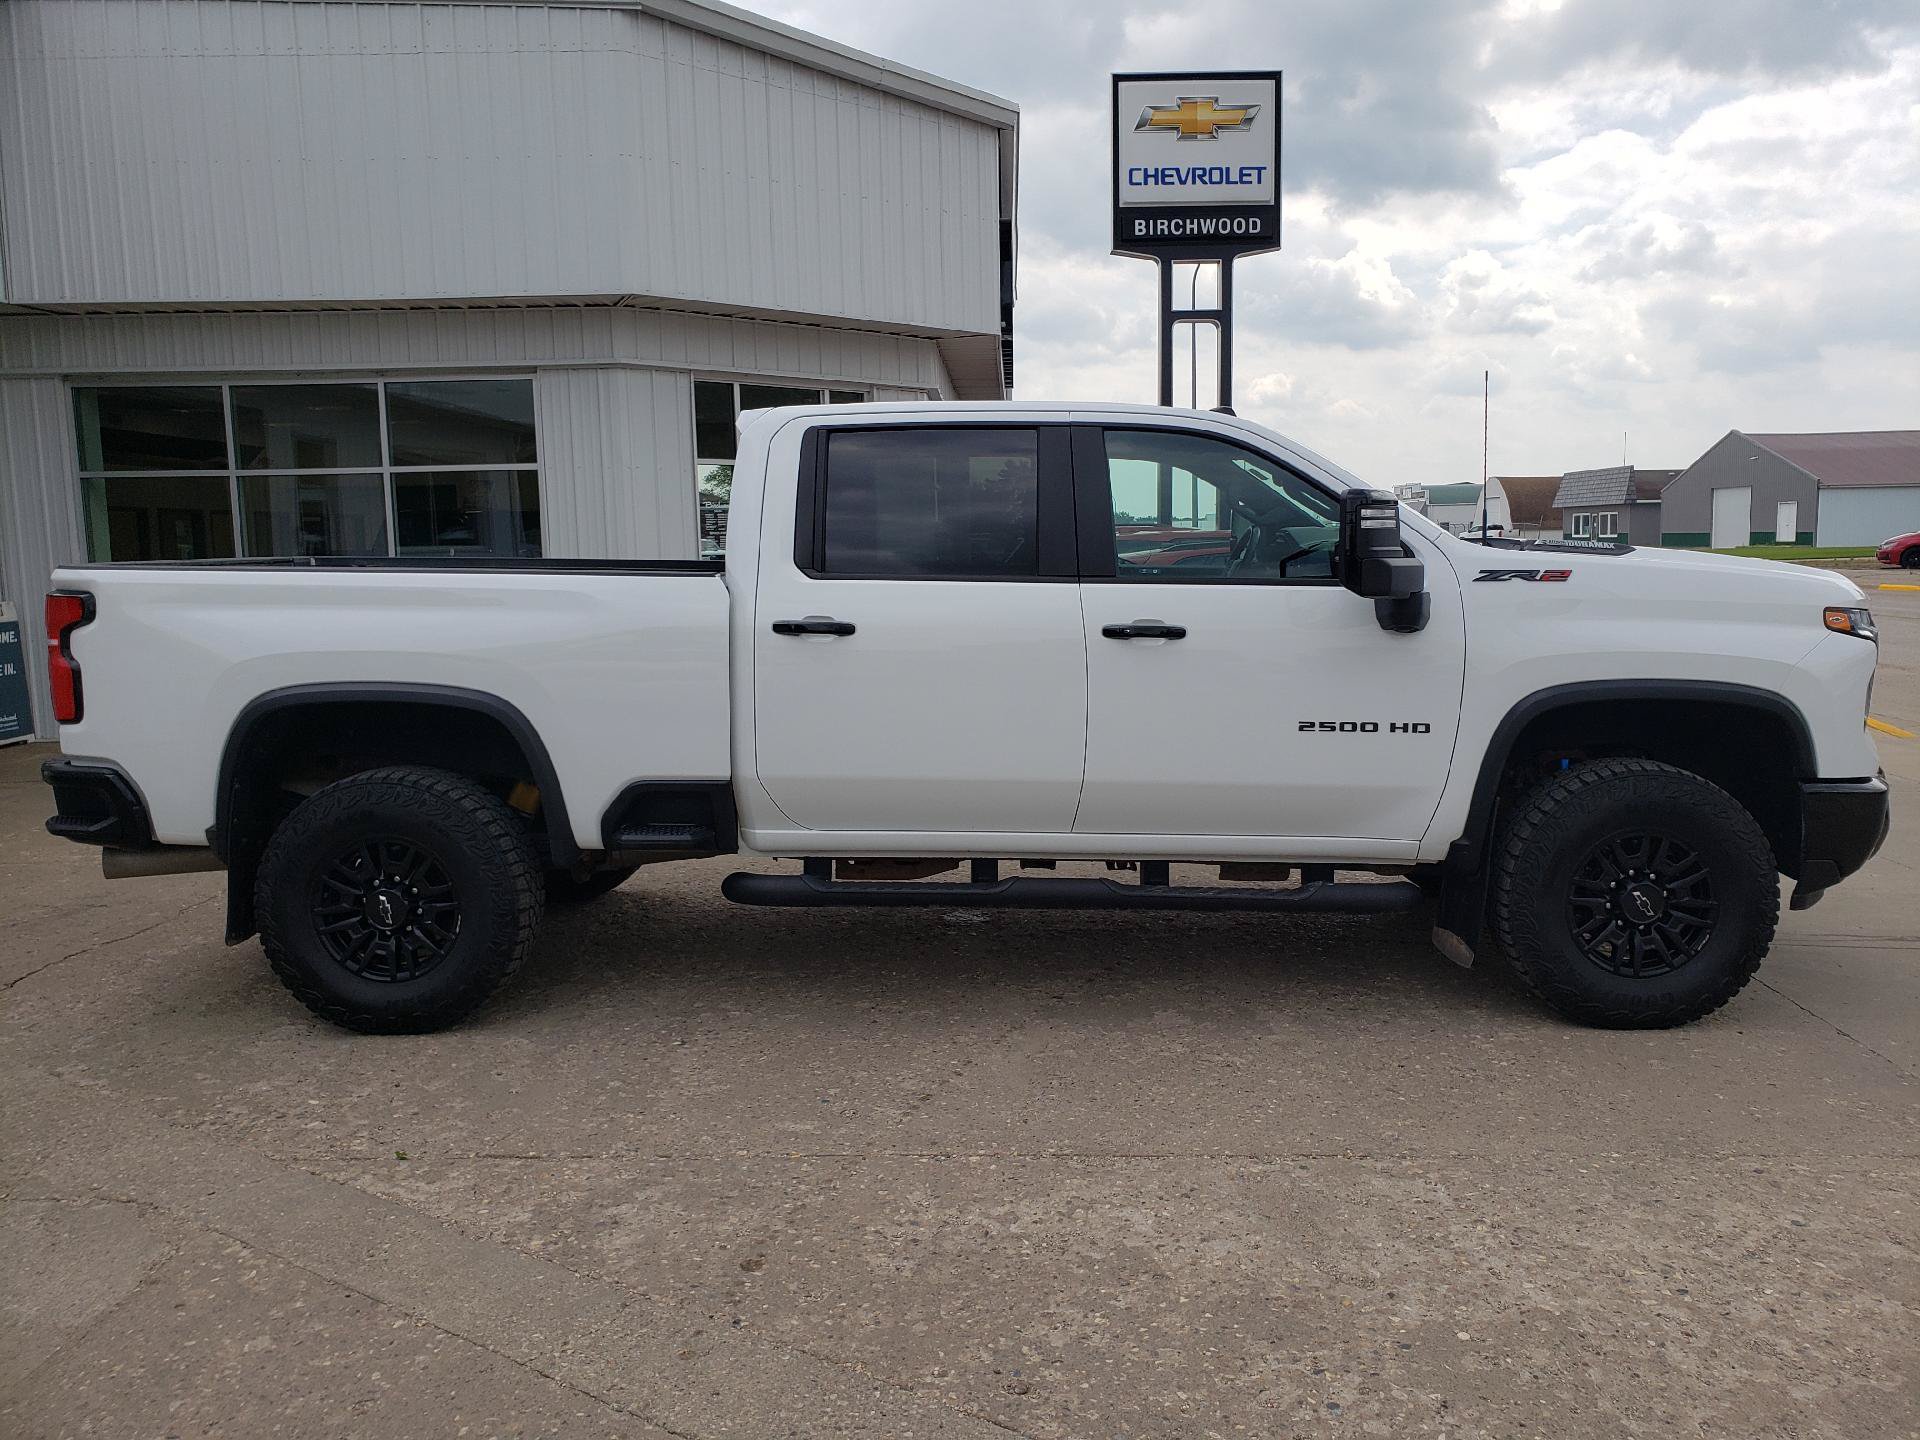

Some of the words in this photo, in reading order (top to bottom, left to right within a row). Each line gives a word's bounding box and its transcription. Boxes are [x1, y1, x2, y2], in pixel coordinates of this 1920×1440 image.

[1128, 166, 1267, 186] CHEVROLET
[1134, 217, 1262, 236] BIRCHWOOD
[1472, 569, 1573, 582] ZR2
[1298, 721, 1379, 733] 2500
[1389, 722, 1431, 734] HD
